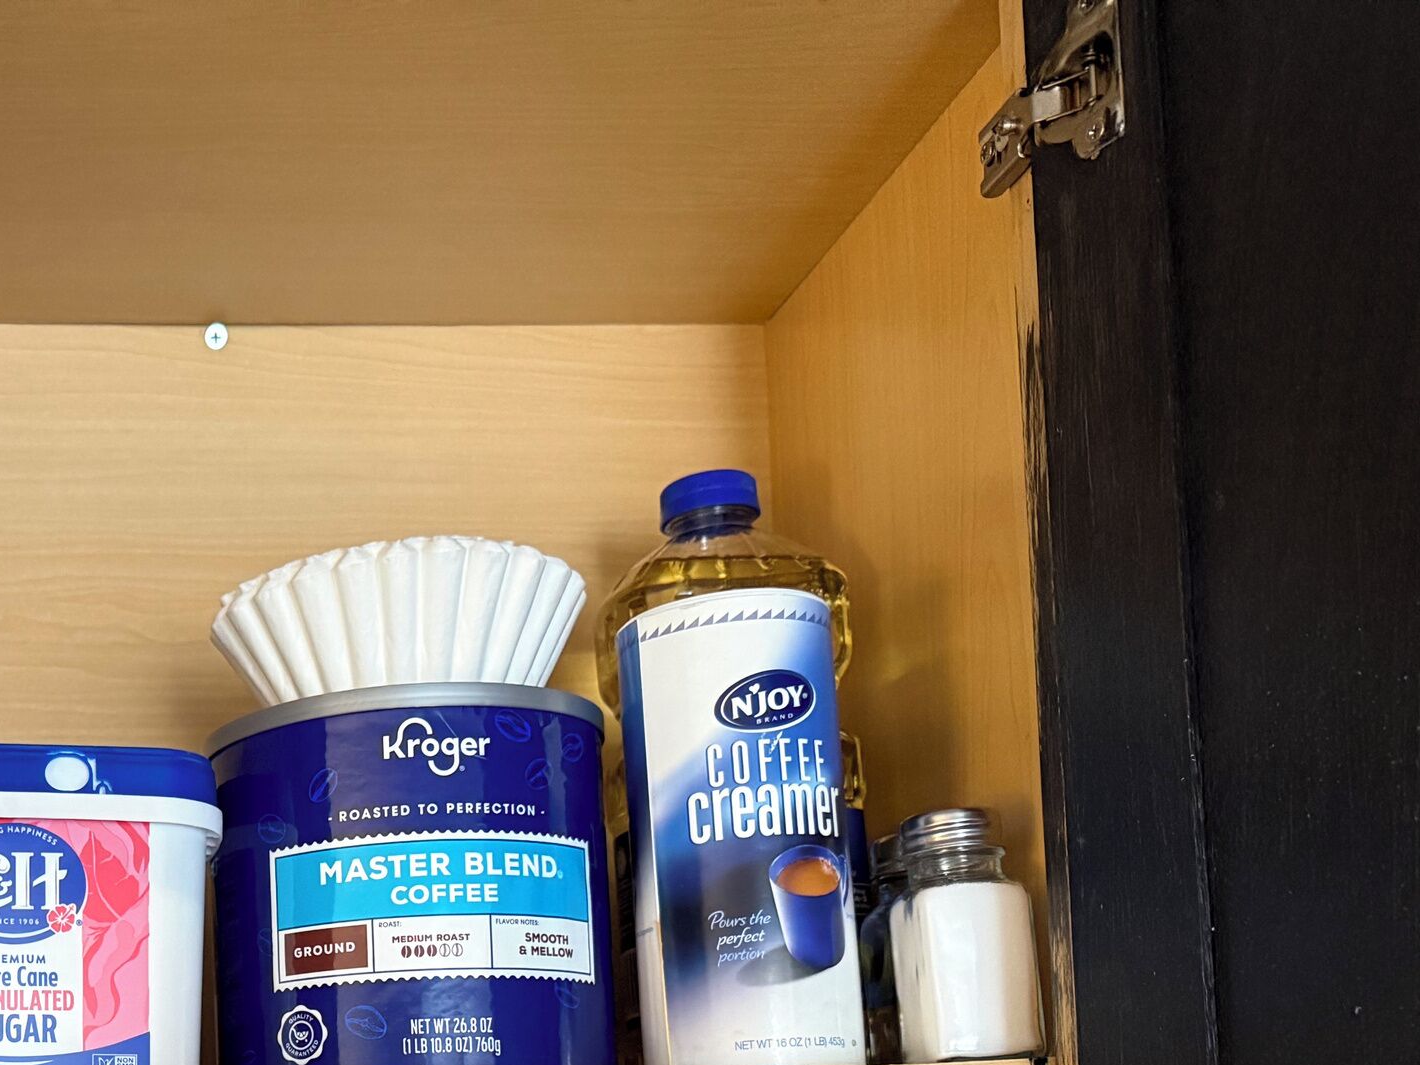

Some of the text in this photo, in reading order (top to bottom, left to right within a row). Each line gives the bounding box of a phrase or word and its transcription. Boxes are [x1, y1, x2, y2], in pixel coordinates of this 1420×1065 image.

[756, 713, 794, 724] BRAND
[382, 717, 490, 776] Kroger
[706, 738, 826, 788] COFFEE
[339, 803, 536, 822] ROASTED TO PERFECTION
[687, 783, 839, 845] creamer
[7, 825, 58, 846] HAPPINESS
[319, 852, 557, 886] MASTER BLEND
[390, 883, 499, 905] COFFEE
[18, 918, 40, 926] 1906
[708, 909, 772, 930] Pours the
[392, 933, 470, 944] MEDIUM ROAST
[525, 932, 569, 945] SMOOTH
[716, 926, 766, 951] perfect
[294, 941, 356, 958] GROUND
[519, 946, 574, 958] & MELLOW
[718, 948, 765, 968] portion
[17, 966, 58, 987] Cane
[288, 1013, 314, 1024] QUALITY
[410, 1017, 494, 1034] NET WT 26.8 OZ
[286, 1040, 319, 1057] GUARANTEED
[402, 1036, 501, 1056] (1 LB 10.8 OZ) 760g
[734, 1040, 754, 1050] NET
[756, 1038, 772, 1048] WT
[776, 1038, 787, 1048] 16
[789, 1037, 802, 1048] OZ
[804, 1037, 811, 1048] (1
[814, 1036, 827, 1048] LB)
[828, 1036, 845, 1048] 453g
